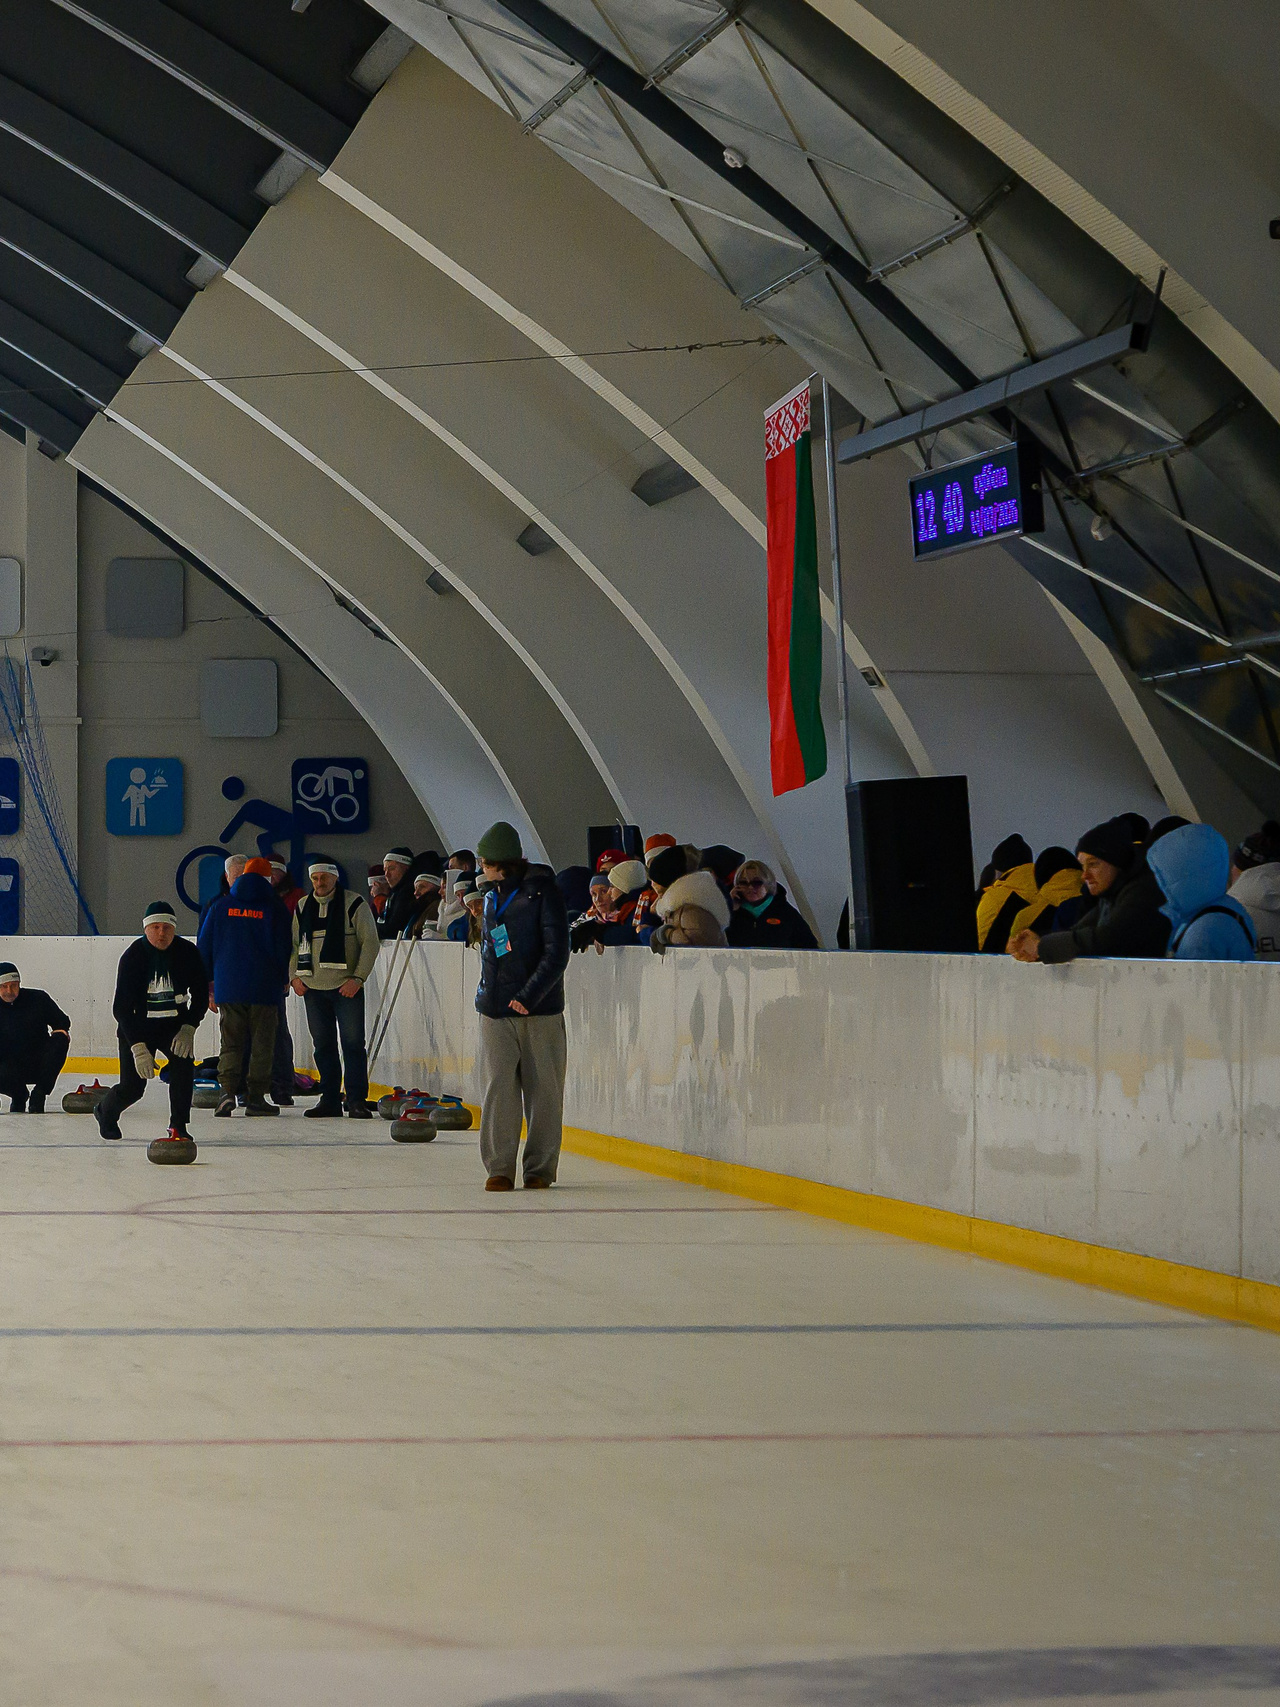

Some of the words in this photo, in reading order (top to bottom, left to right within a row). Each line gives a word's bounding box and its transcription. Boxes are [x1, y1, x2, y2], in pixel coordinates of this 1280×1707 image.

[916, 490, 938, 542] 12
[942, 481, 964, 534] 40
[228, 908, 263, 919] BELARUS
